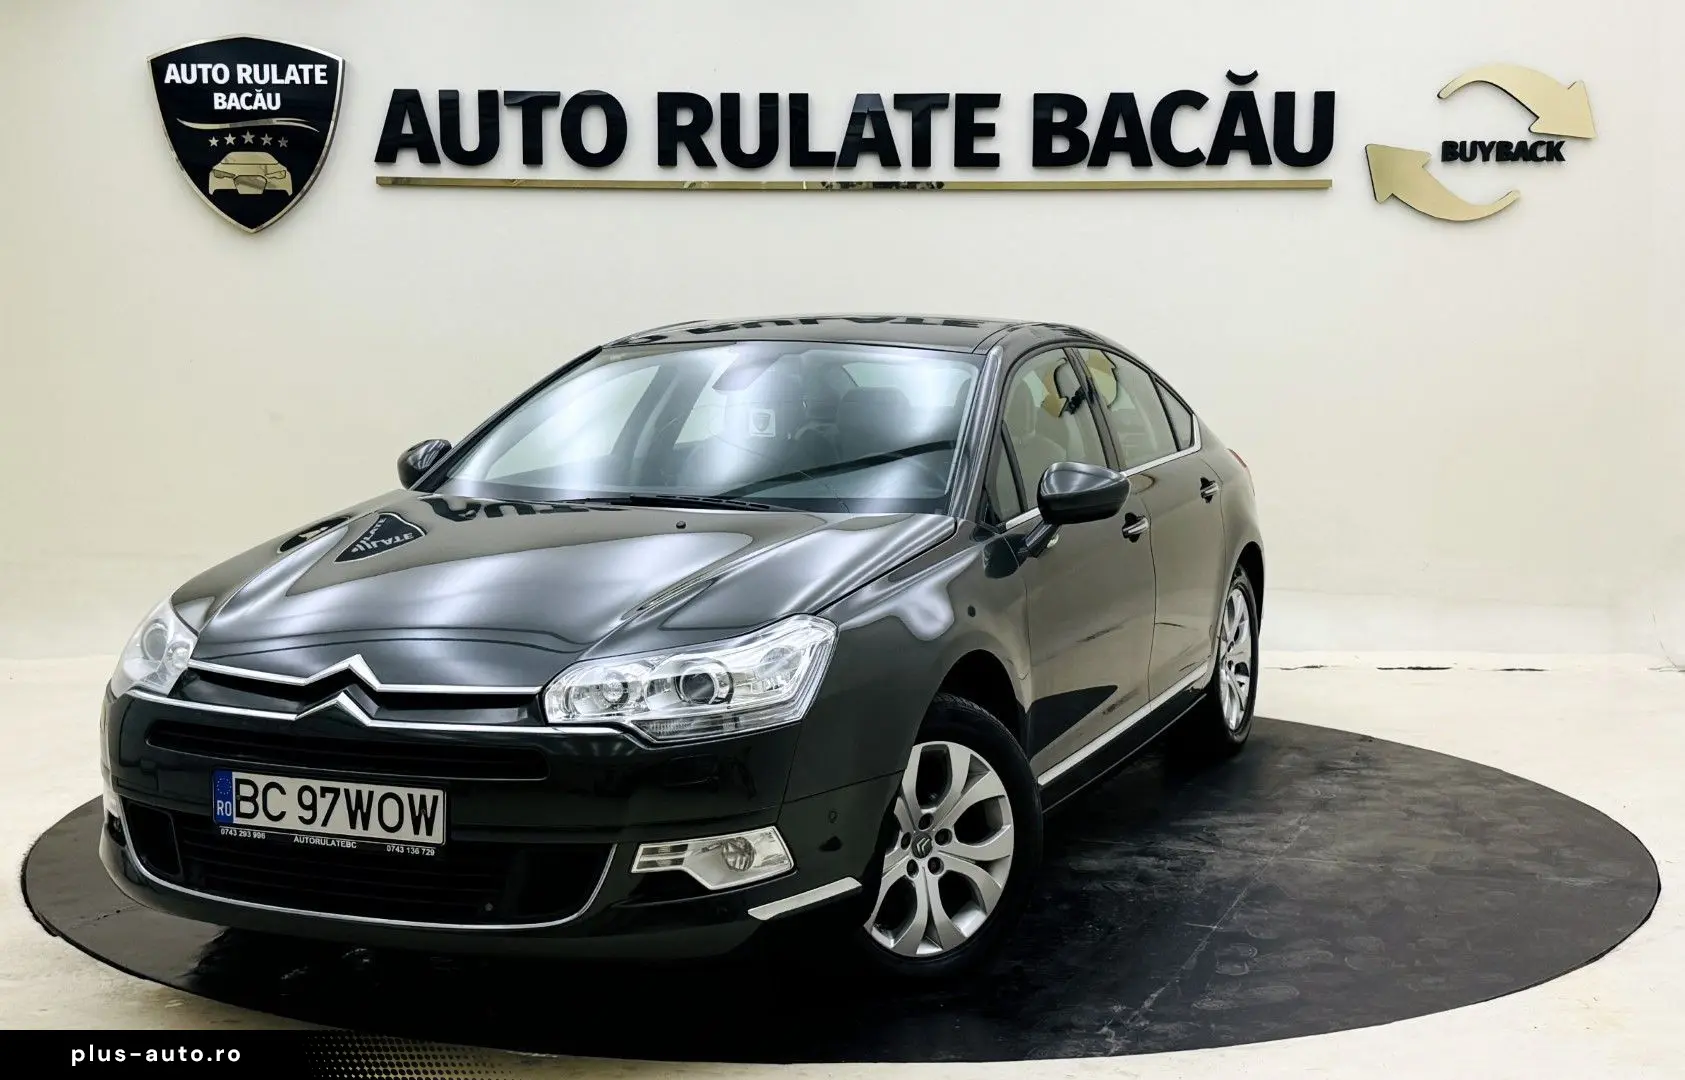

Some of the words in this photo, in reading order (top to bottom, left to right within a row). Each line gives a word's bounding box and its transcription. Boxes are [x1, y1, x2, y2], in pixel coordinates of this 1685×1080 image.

[164, 63, 230, 84] AUTO
[236, 63, 328, 86] RULATE
[213, 88, 281, 111] BACĂU
[374, 88, 628, 169] AUTO
[657, 91, 1002, 169] RULATE
[1031, 69, 1336, 169] BACĂU
[1441, 140, 1566, 162] BUYBACK
[216, 800, 232, 817] RO
[234, 778, 286, 822] BC
[297, 785, 439, 837] 97WOW
[293, 835, 357, 849] AUTORULATEBC
[386, 845, 404, 853] 0743
